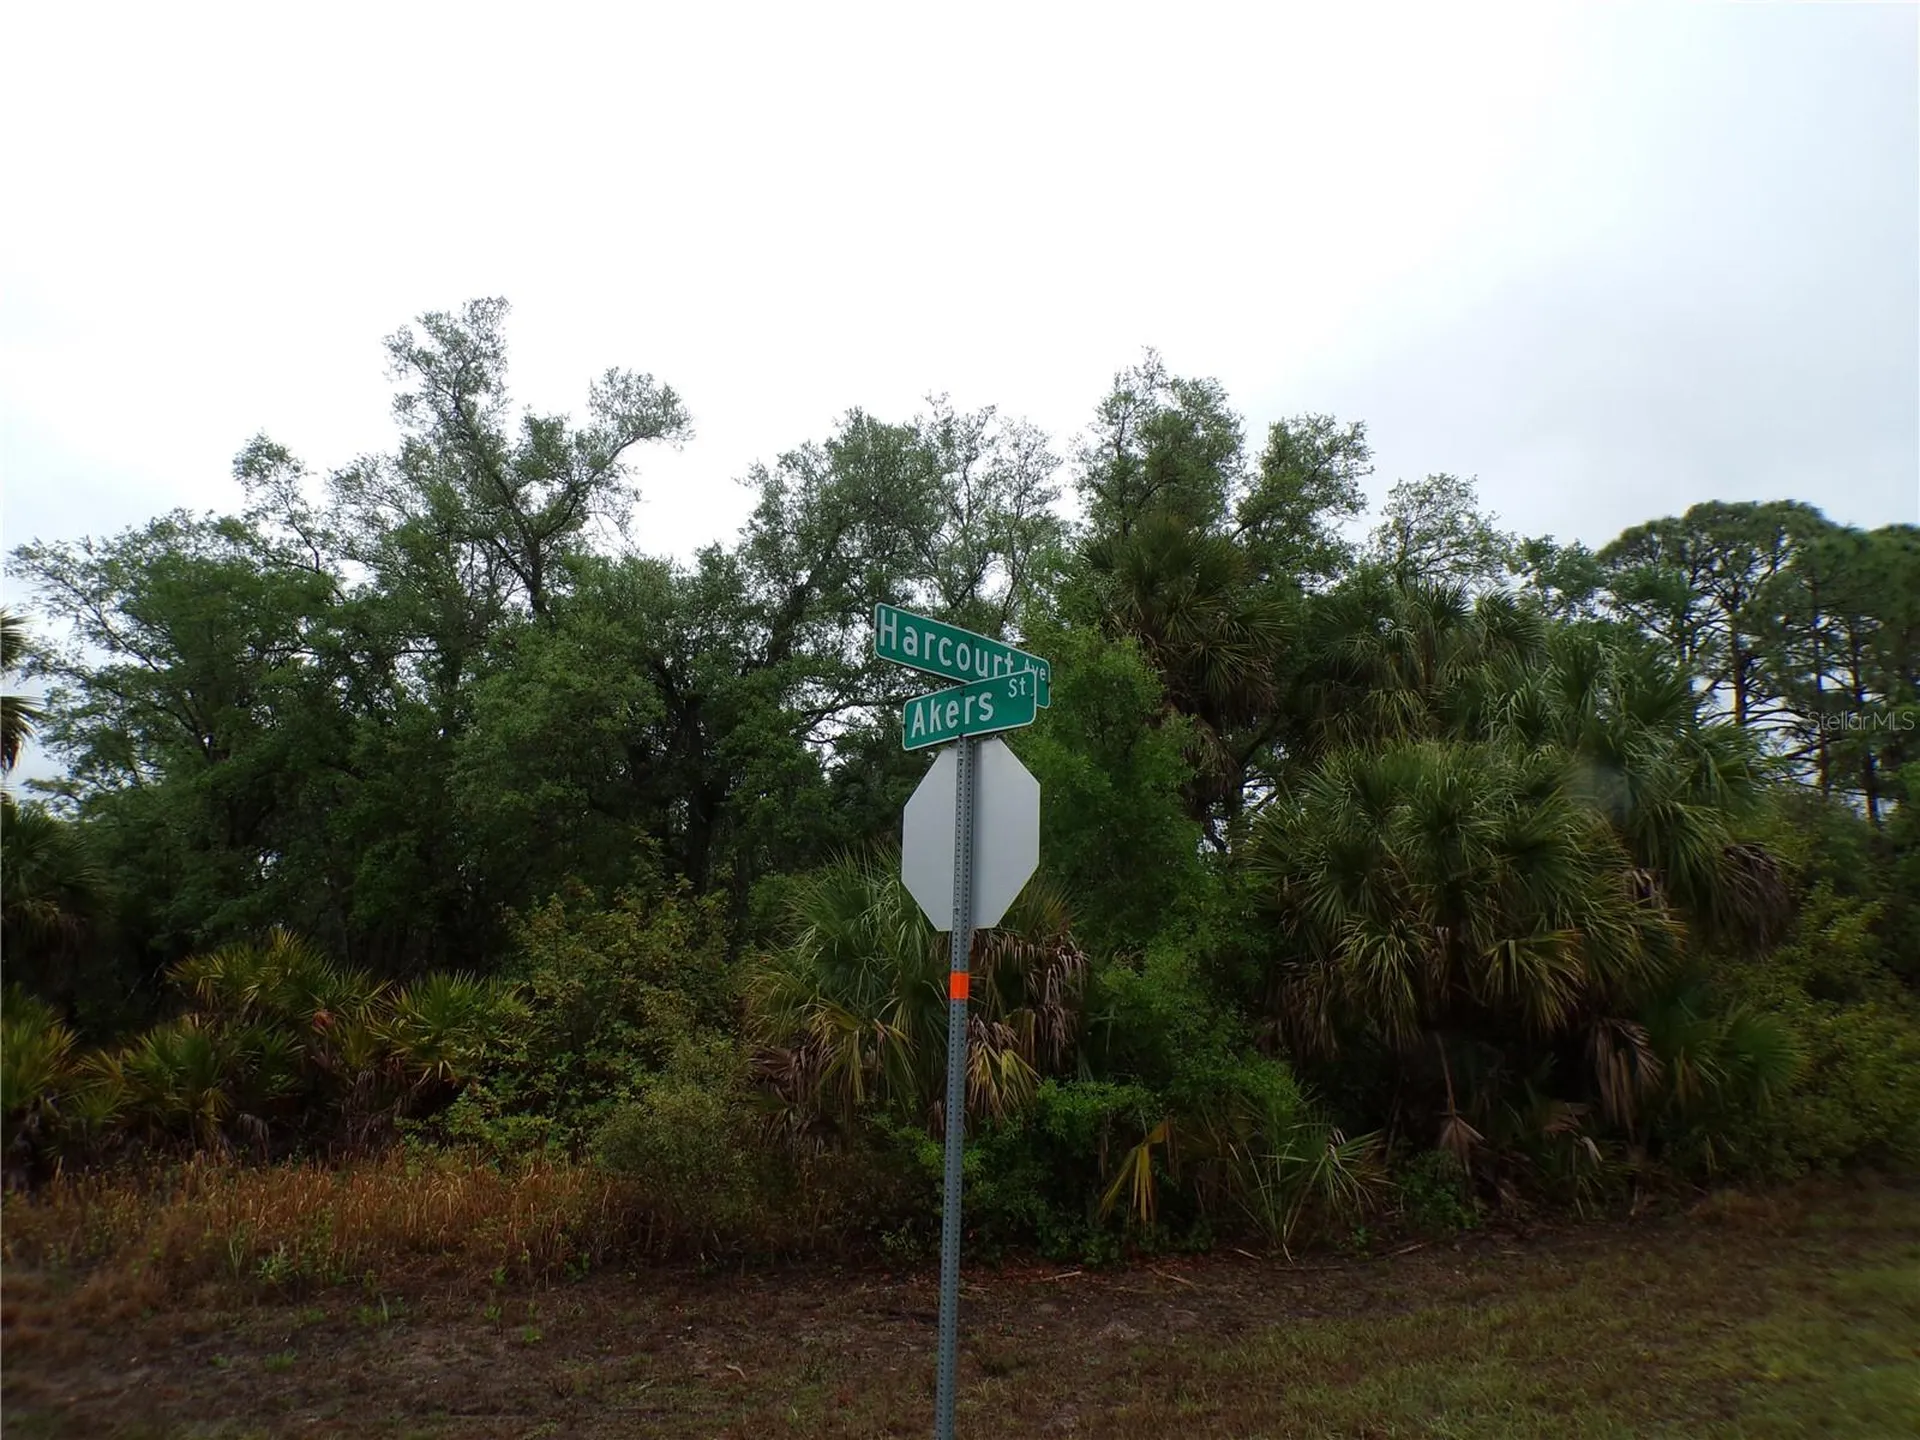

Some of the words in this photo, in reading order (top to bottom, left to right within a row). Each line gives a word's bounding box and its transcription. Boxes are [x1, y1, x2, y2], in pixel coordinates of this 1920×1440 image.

[879, 608, 1014, 678] Harcourt
[910, 691, 994, 738] Akers
[1008, 677, 1026, 698] St
